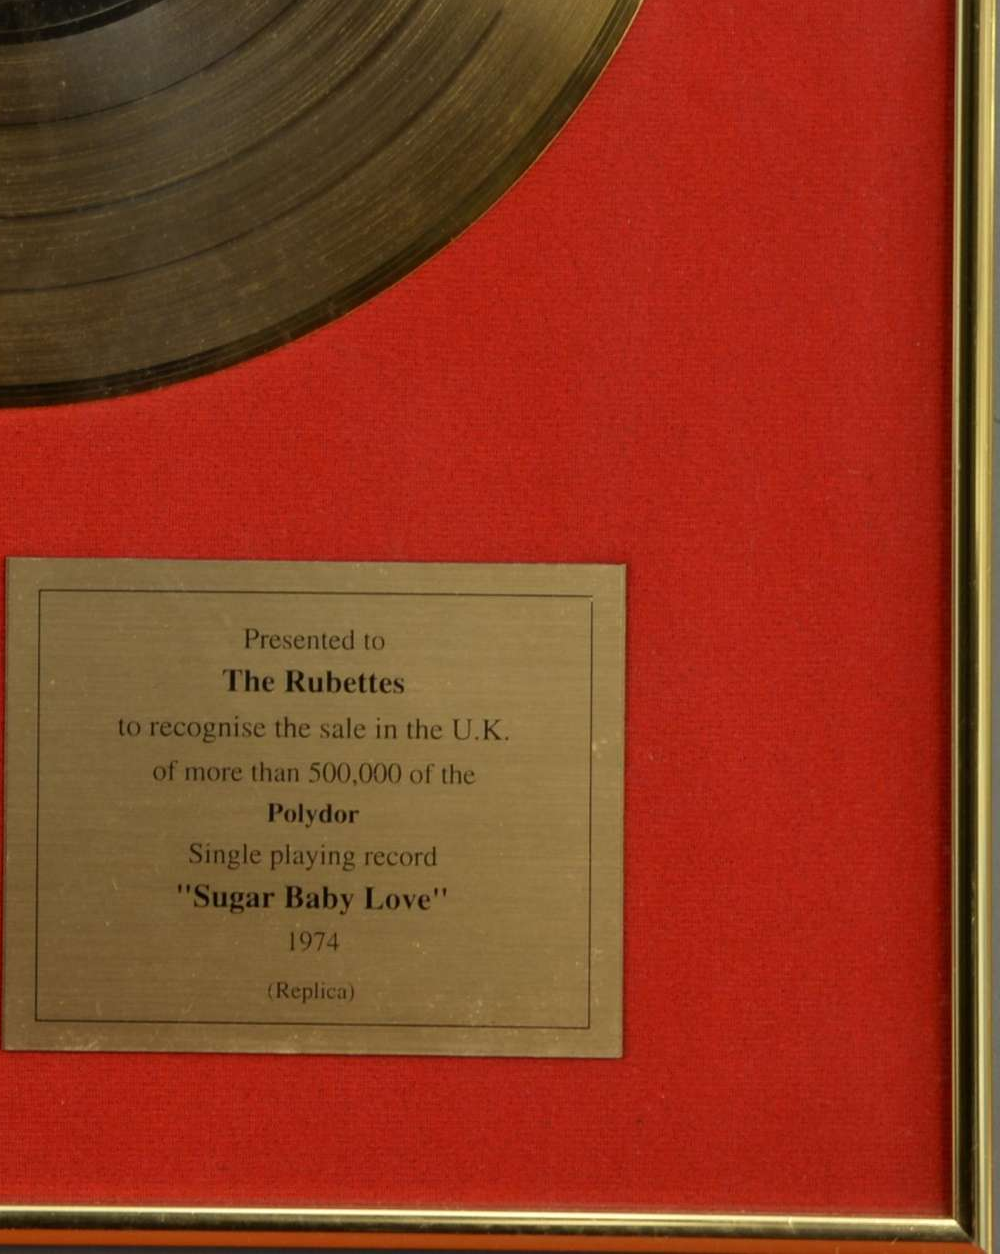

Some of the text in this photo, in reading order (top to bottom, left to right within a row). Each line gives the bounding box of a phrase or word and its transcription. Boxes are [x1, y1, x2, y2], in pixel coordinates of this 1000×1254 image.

[244, 628, 385, 651] Presented to
[223, 669, 406, 694] The Rubettes
[118, 715, 510, 743] to recognise the sale in the U.K.
[152, 759, 477, 786] of more than 500,000 of the
[267, 803, 360, 828] Polydor
[188, 843, 438, 871] Single playing record
[285, 885, 354, 915] Baby
[288, 931, 340, 952] 1974
[267, 982, 355, 1004] (Replica)
